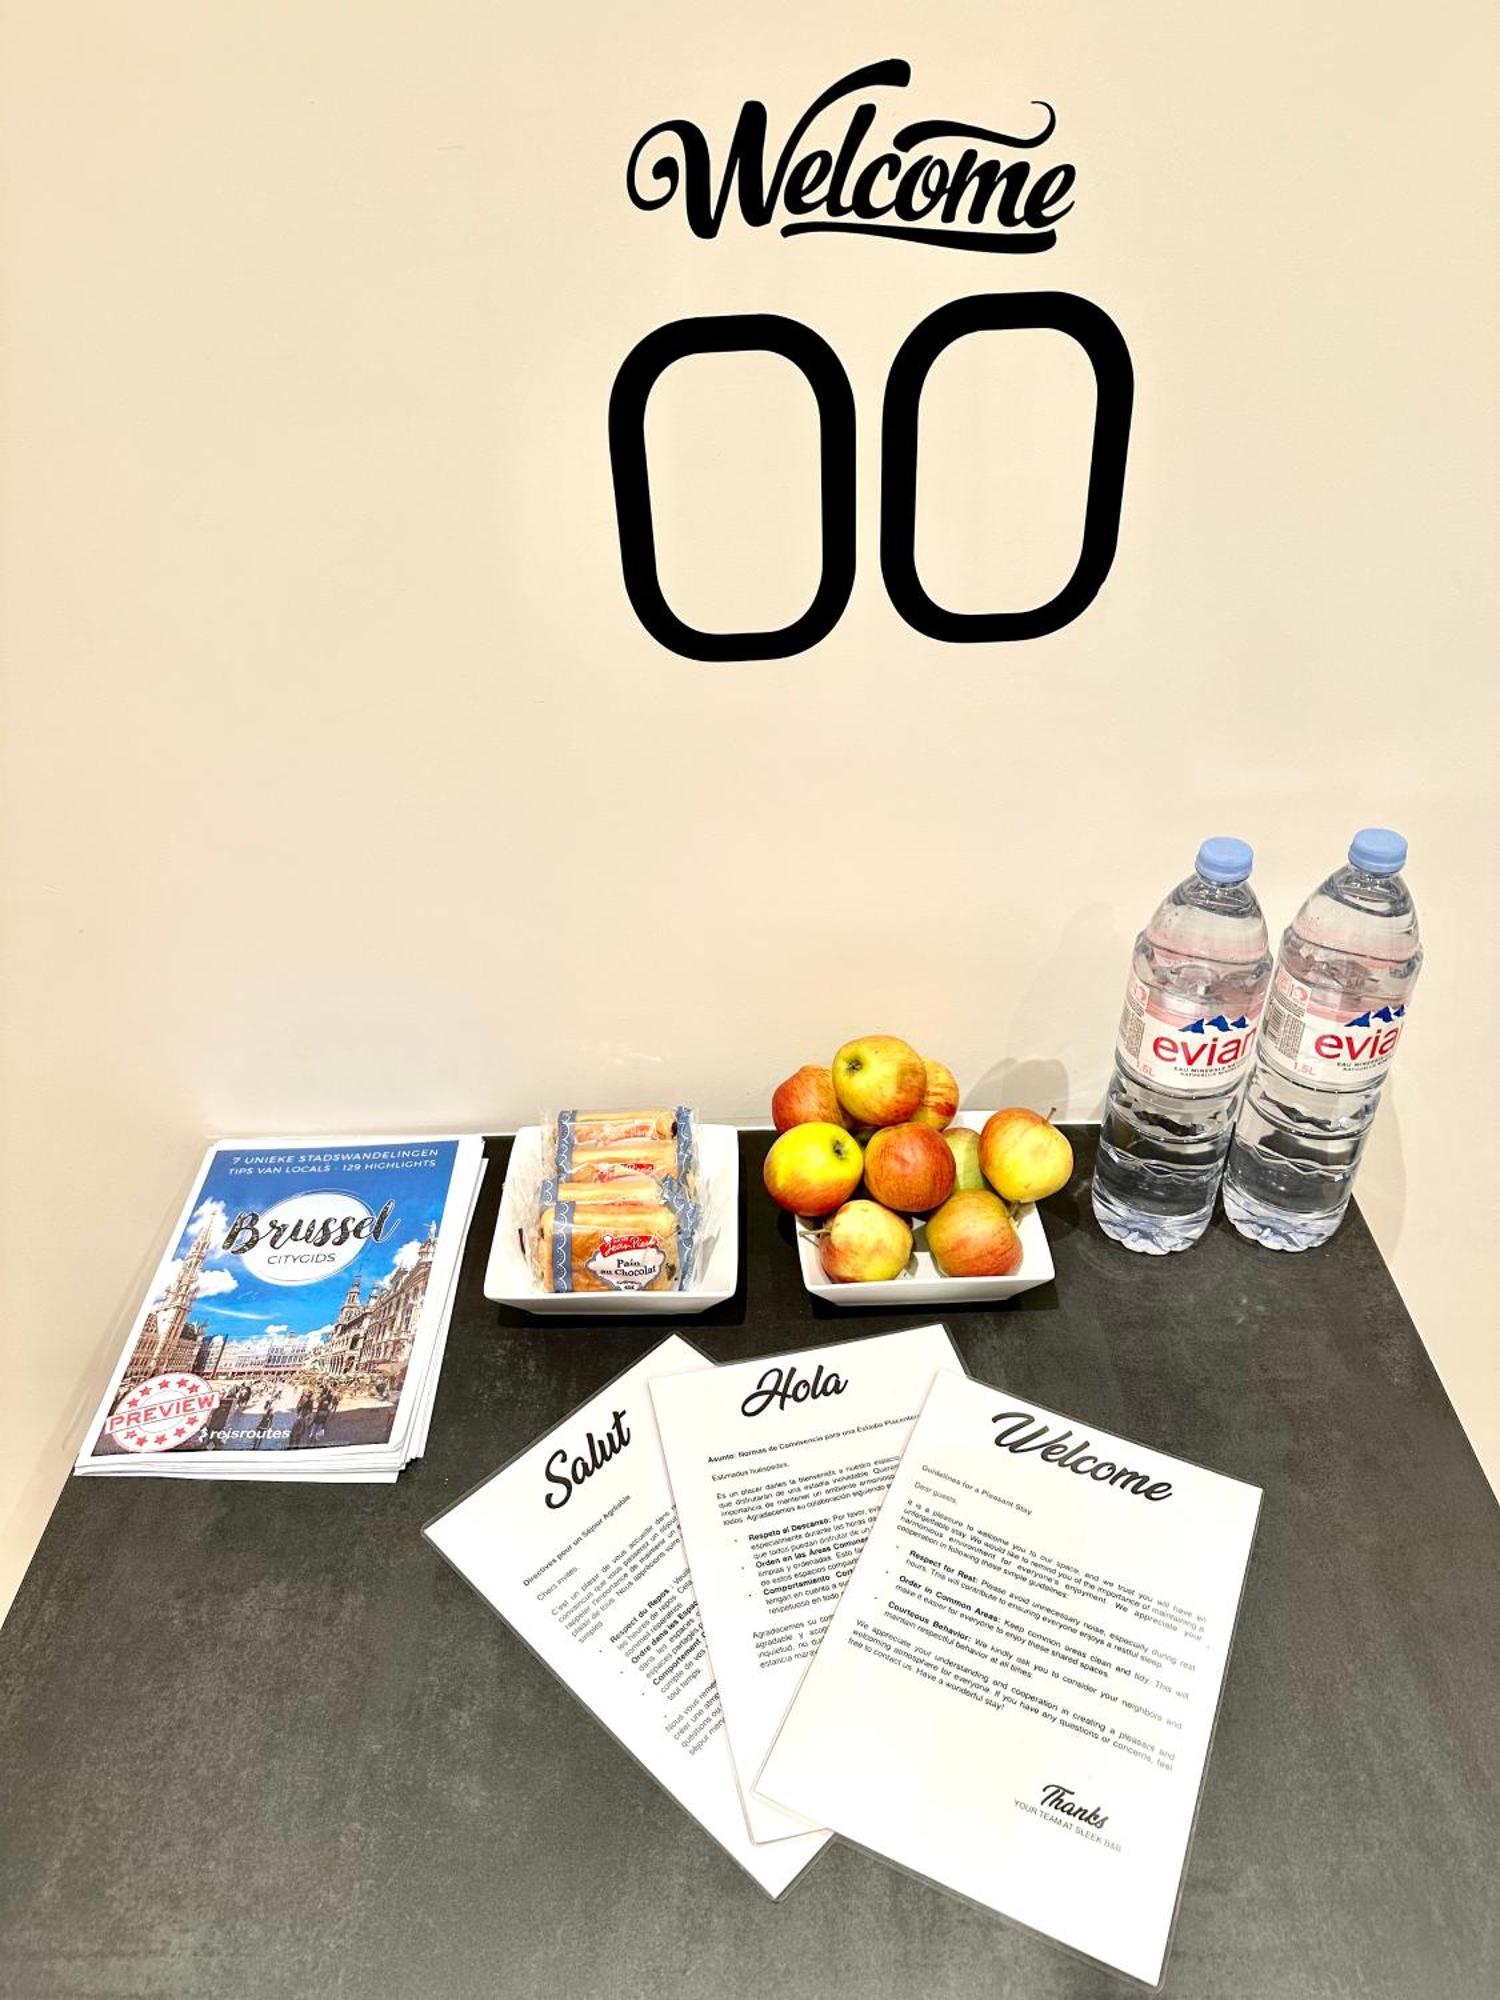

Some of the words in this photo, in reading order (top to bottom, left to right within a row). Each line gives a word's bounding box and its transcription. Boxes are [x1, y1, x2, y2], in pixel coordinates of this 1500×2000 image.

[626, 58, 1076, 254] Welcome
[1314, 1026, 1401, 1060] evia
[229, 1167, 254, 1176] TIPS
[257, 1166, 282, 1175] VAN
[286, 1164, 330, 1174] LOCALS
[342, 1163, 361, 1172] 129
[364, 1159, 437, 1171] HIGHLIGHTS
[231, 1156, 242, 1166] 7
[244, 1154, 295, 1165] UNIEKE
[298, 1149, 438, 1163] STADSWANDELINGEN
[222, 1199, 401, 1255] Brussel
[614, 1265, 657, 1277] Chocolat
[617, 1258, 641, 1268] Pain
[109, 1394, 215, 1431] PREVIEW
[741, 1365, 848, 1417] Hola
[545, 1409, 631, 1509] Salut
[737, 1447, 768, 1458] Normas
[778, 1435, 824, 1450] Convivencia
[823, 1432, 841, 1441] para
[841, 1428, 856, 1437] una
[856, 1422, 884, 1433] Estadía
[992, 1412, 1173, 1501] Welcome
[921, 1464, 961, 1486] Guidelines
[961, 1481, 974, 1490] for
[980, 1488, 1014, 1508] Pleasant
[1015, 1503, 1033, 1516] Stay
[522, 1558, 558, 1587] Directives
[556, 1544, 573, 1561] pour
[581, 1518, 604, 1538] Séjour
[602, 1495, 631, 1521] Agréable
[748, 1529, 781, 1541] Respeto
[831, 1514, 845, 1522] Por
[755, 1557, 781, 1569] Orden
[794, 1552, 807, 1560] las
[808, 1546, 832, 1556] Áreas
[762, 1575, 831, 1596] Comportamiento
[909, 1549, 942, 1569] Respect
[943, 1564, 955, 1574] for
[980, 1579, 1007, 1596] Please
[1008, 1592, 1031, 1605] avoid
[1031, 1601, 1081, 1627] unnecessary
[1108, 1632, 1149, 1654] especially
[1151, 1648, 1177, 1666] during
[609, 1616, 639, 1644] Respect
[647, 1588, 670, 1609] Repos
[899, 1575, 922, 1590] Order
[935, 1591, 972, 1612] Common
[1003, 1619, 1025, 1633] Keep
[1027, 1629, 1061, 1649] common
[1063, 1644, 1087, 1659] areas
[1089, 1655, 1112, 1669] clean
[1115, 1665, 1132, 1677] and
[631, 1644, 652, 1664] Ordre
[651, 1628, 669, 1647] dans
[666, 1619, 680, 1631] les
[652, 1637, 702, 1686] Comportement
[887, 1600, 930, 1625] Courteous
[990, 1645, 1014, 1661] kindly
[1015, 1656, 1031, 1668] ask
[1033, 1663, 1049, 1675] you
[1061, 1675, 1098, 1694] consider
[1099, 1691, 1119, 1703] your
[1121, 1699, 1162, 1722] neighbors
[1014, 1798, 1038, 1815] YOUR
[1039, 1809, 1063, 1826] TEAM
[1062, 1821, 1073, 1831] AT
[1041, 1784, 1109, 1829] Thanks
